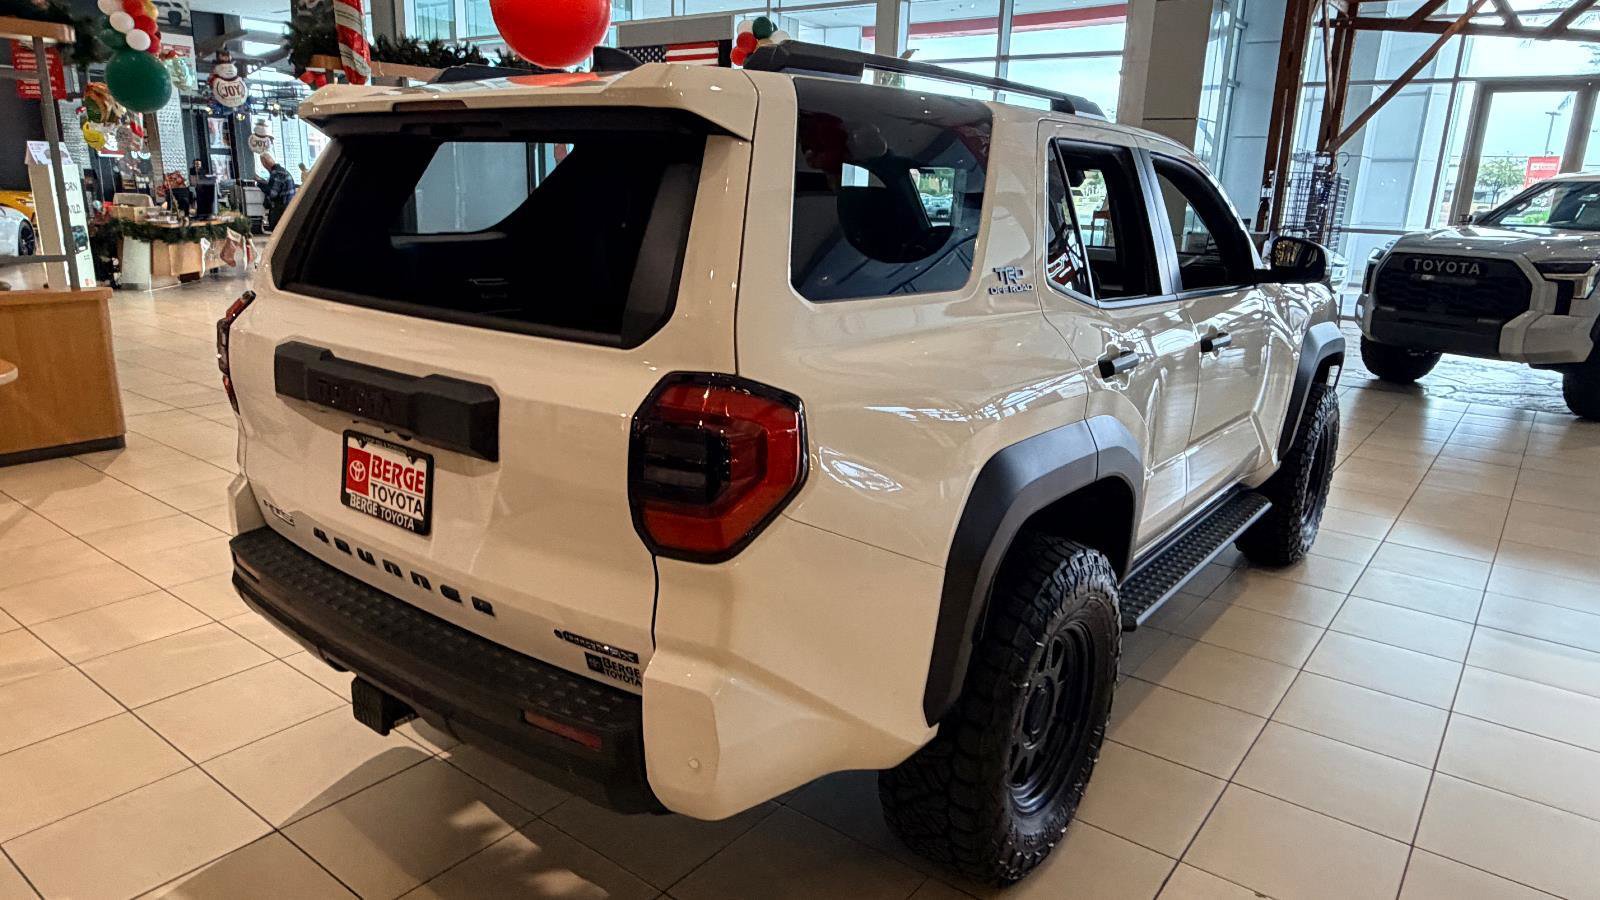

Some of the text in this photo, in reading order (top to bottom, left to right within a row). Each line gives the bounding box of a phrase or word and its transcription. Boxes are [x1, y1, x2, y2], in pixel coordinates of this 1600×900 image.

[222, 84, 241, 98] JOY
[992, 265, 1024, 285] TRD
[1413, 258, 1480, 275] TOYOTA
[371, 454, 425, 495] BERGE
[370, 482, 424, 516] TOYOTA
[350, 493, 415, 531] BERGE TOYOTA
[602, 656, 640, 678] BERGE
[604, 668, 642, 688] TOYOTA
